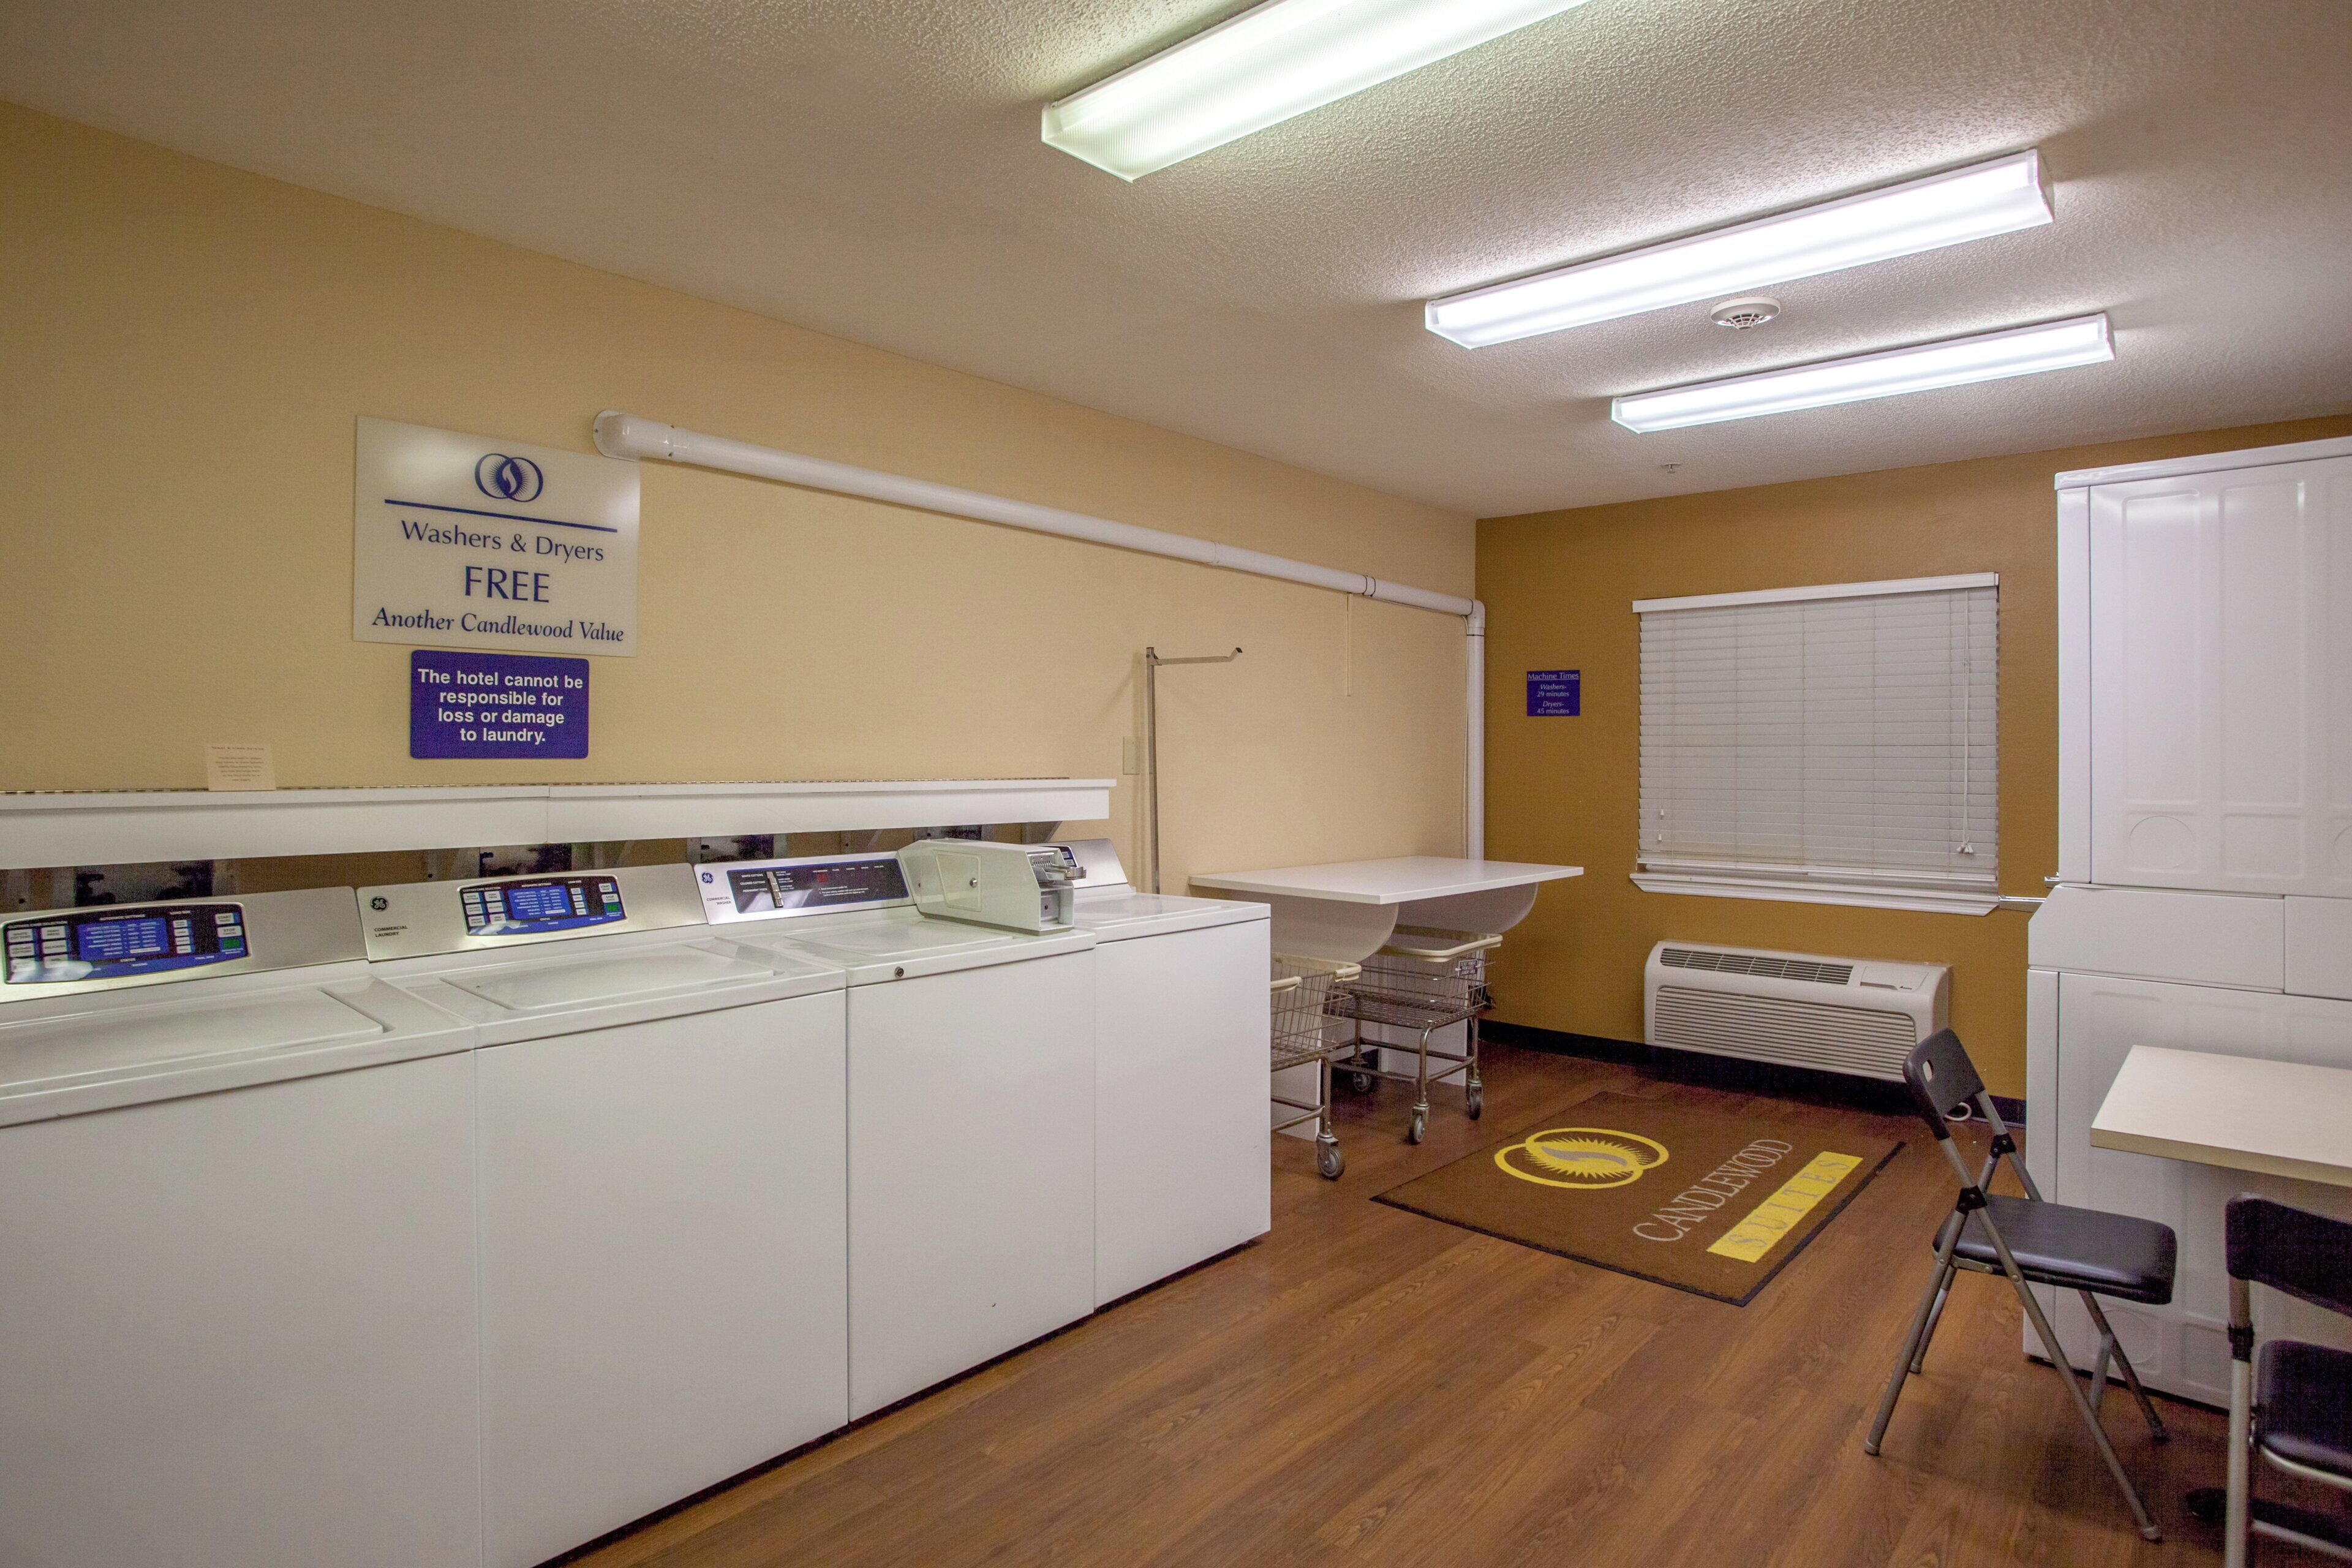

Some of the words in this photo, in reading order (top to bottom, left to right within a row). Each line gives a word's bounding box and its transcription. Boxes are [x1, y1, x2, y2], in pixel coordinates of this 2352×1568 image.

[401, 520, 501, 549] Washers
[510, 533, 526, 552] &
[536, 536, 604, 564] Dryers
[465, 565, 550, 603] FREE
[372, 606, 454, 631] Another
[461, 612, 573, 638] Candlewood
[579, 621, 624, 642] Value
[418, 668, 451, 684] The
[457, 671, 499, 685] hotel
[504, 675, 559, 688] cannot
[565, 675, 583, 689] be
[440, 691, 537, 707] responsible
[541, 692, 563, 706] for
[438, 708, 474, 722] loss
[480, 711, 498, 723] or
[502, 710, 565, 727] damage
[460, 729, 477, 741] to
[483, 728, 546, 745] laundry.
[1632, 1139, 1793, 1242] CANDLEWOOD
[1727, 1159, 1850, 1249] SUITES
